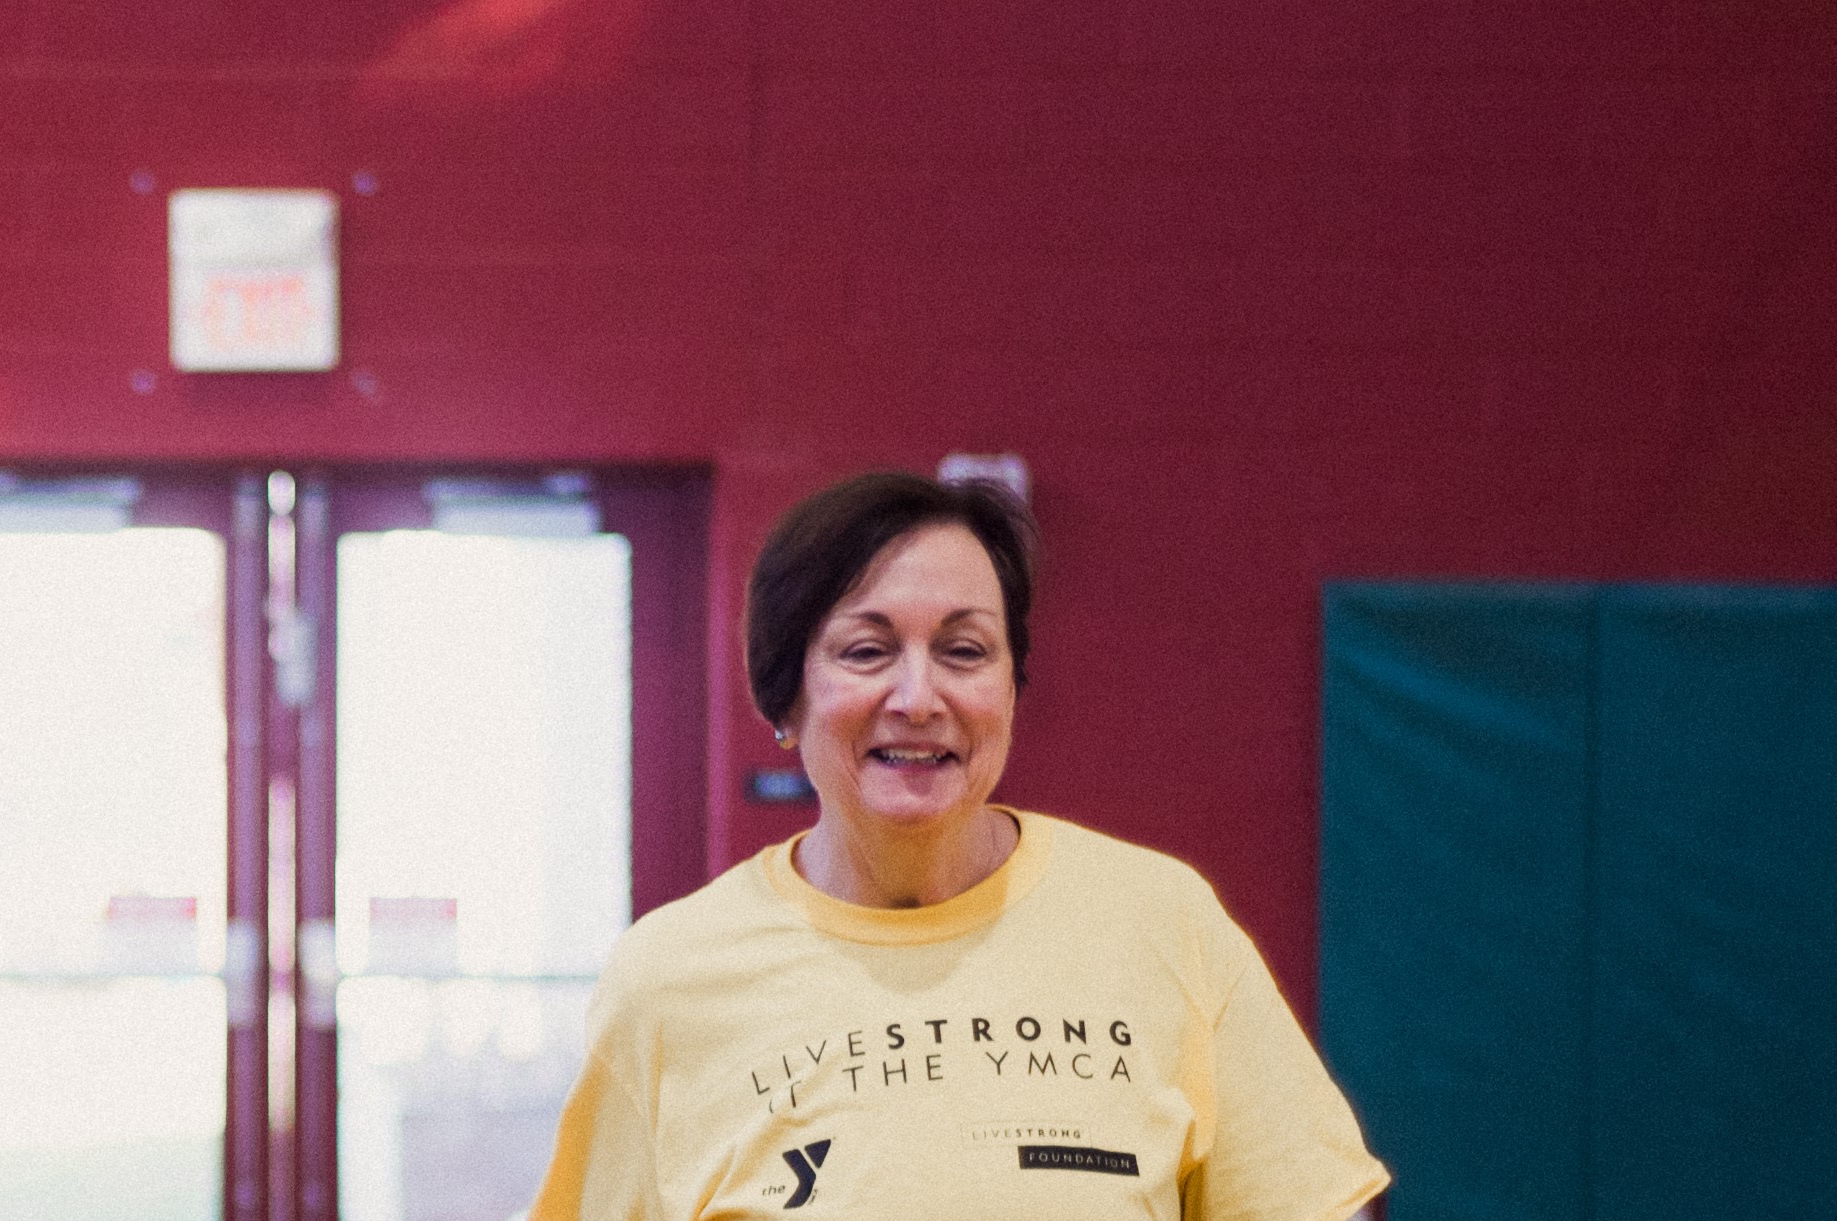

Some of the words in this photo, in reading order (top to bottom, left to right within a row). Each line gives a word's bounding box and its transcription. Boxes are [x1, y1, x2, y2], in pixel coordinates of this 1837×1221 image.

[751, 1016, 1132, 1096] LIVESTRONG
[842, 1054, 943, 1093] THE
[986, 1051, 1131, 1083] YMCA
[971, 1127, 1082, 1141] LIVESTRONG
[1029, 1151, 1131, 1170] FOUNDATION
